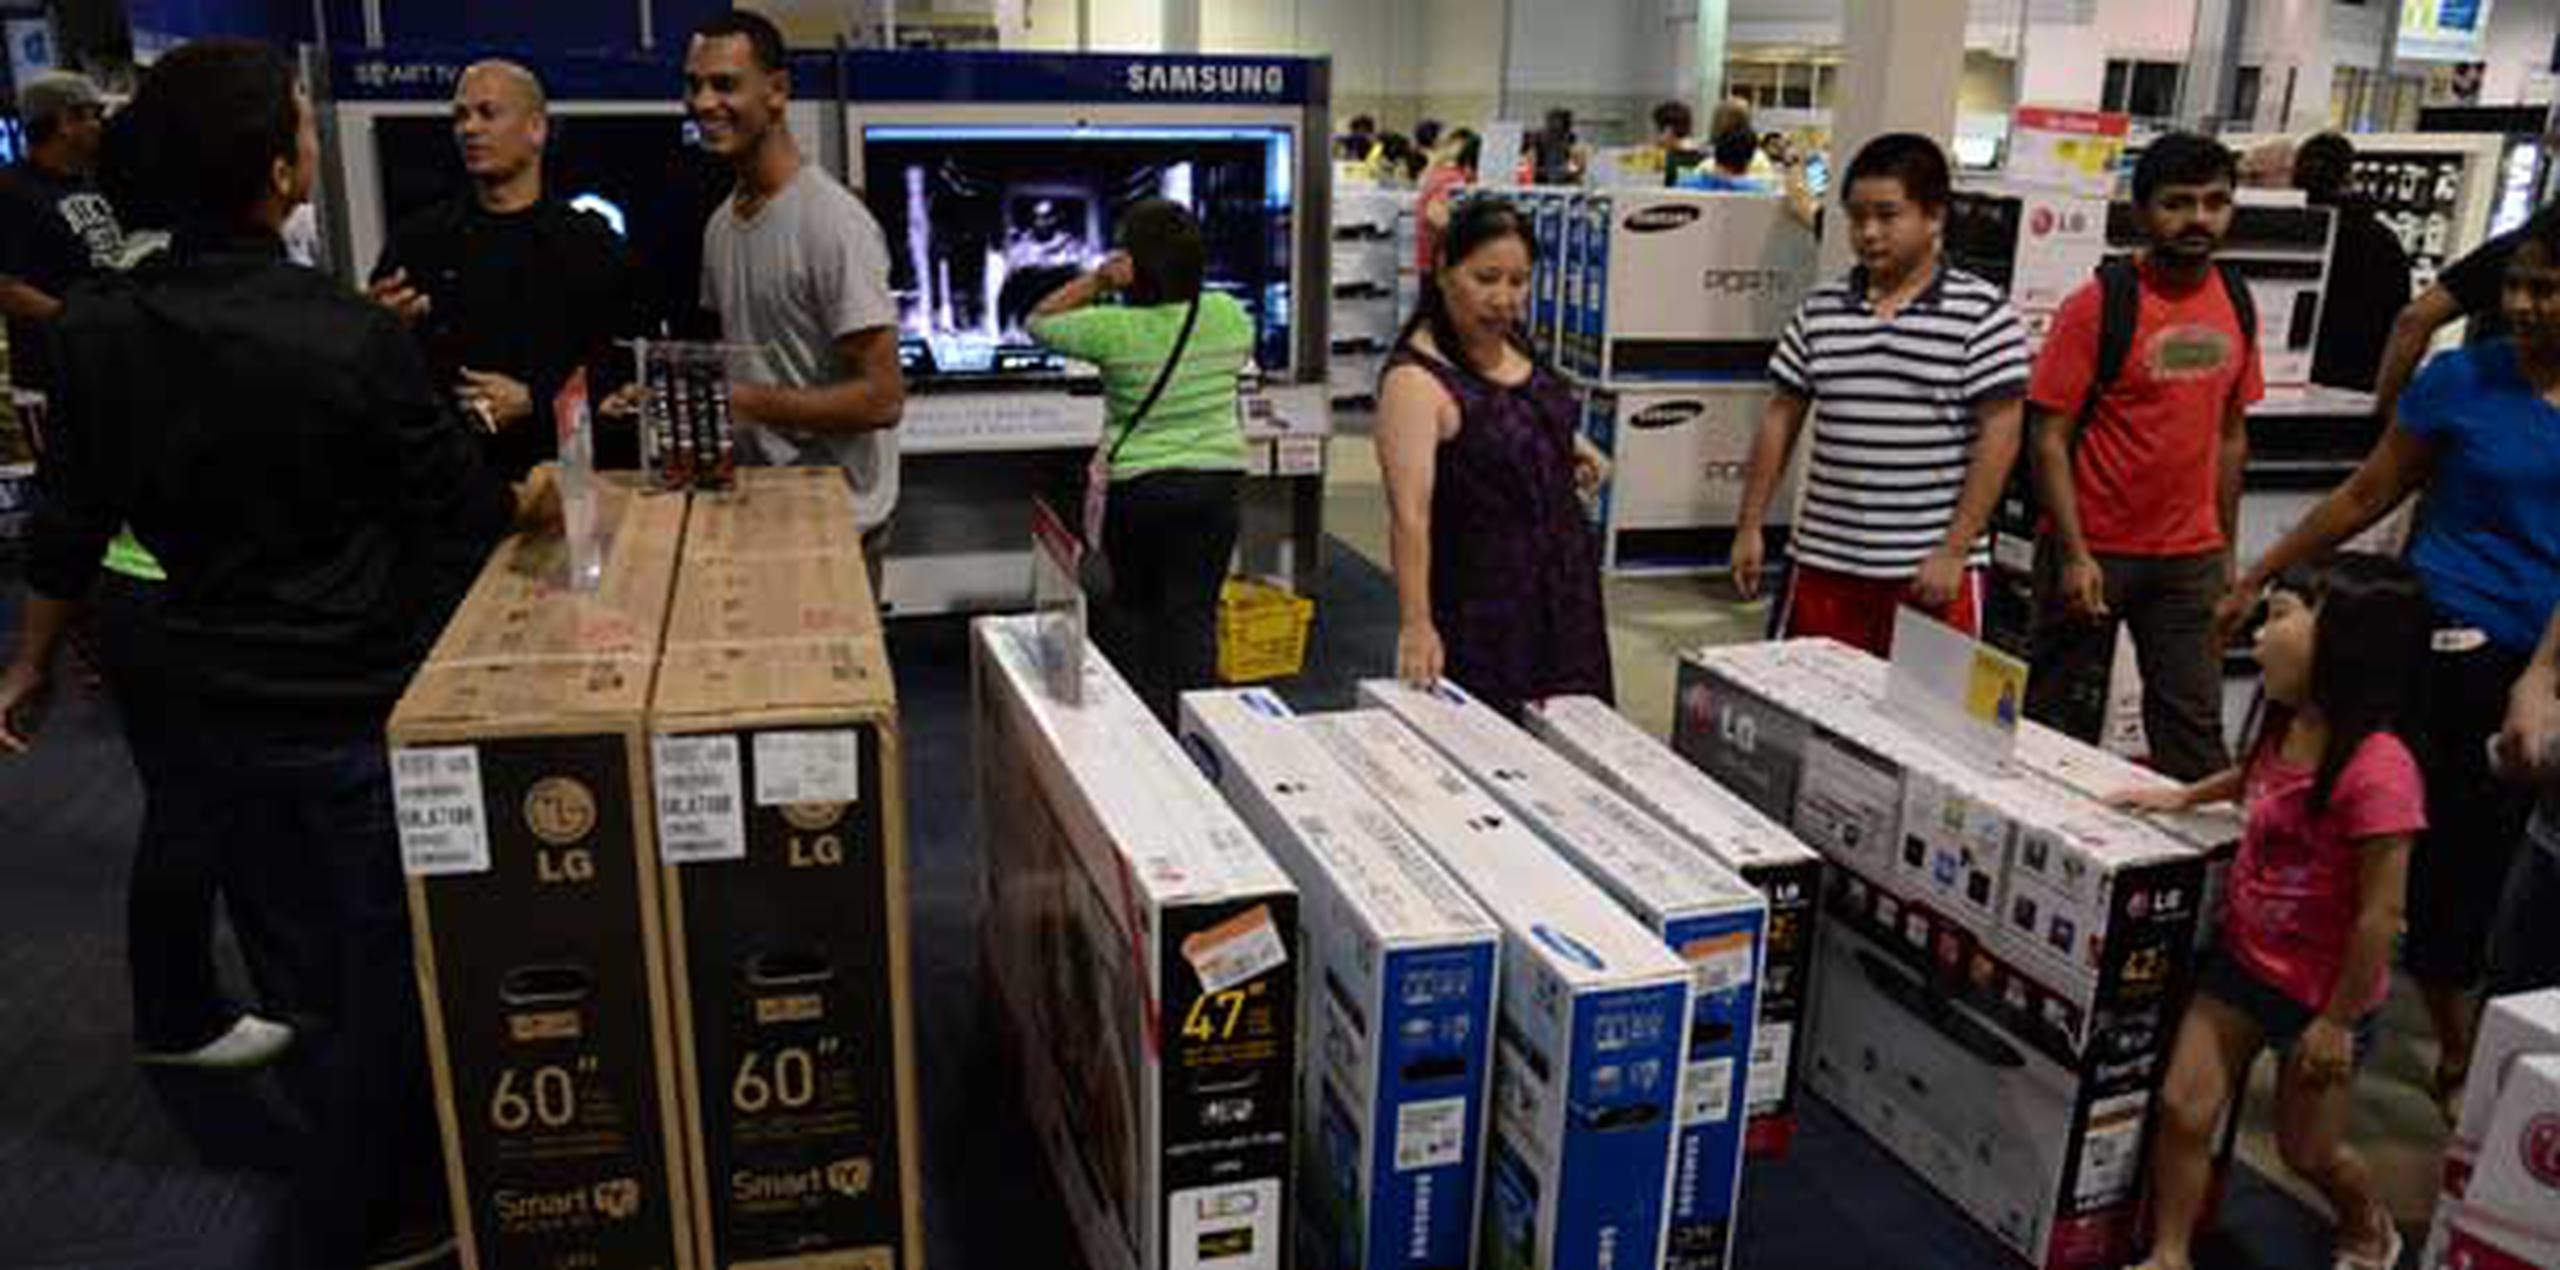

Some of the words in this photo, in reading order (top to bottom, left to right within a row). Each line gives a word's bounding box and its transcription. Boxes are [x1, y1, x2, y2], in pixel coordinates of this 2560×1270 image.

[1128, 64, 1284, 93] SAMSUNG
[1721, 703, 1757, 752] LG
[537, 850, 593, 883] LG
[788, 834, 843, 867] LG
[732, 1167, 823, 1202] Smart
[495, 1187, 588, 1220] Smart
